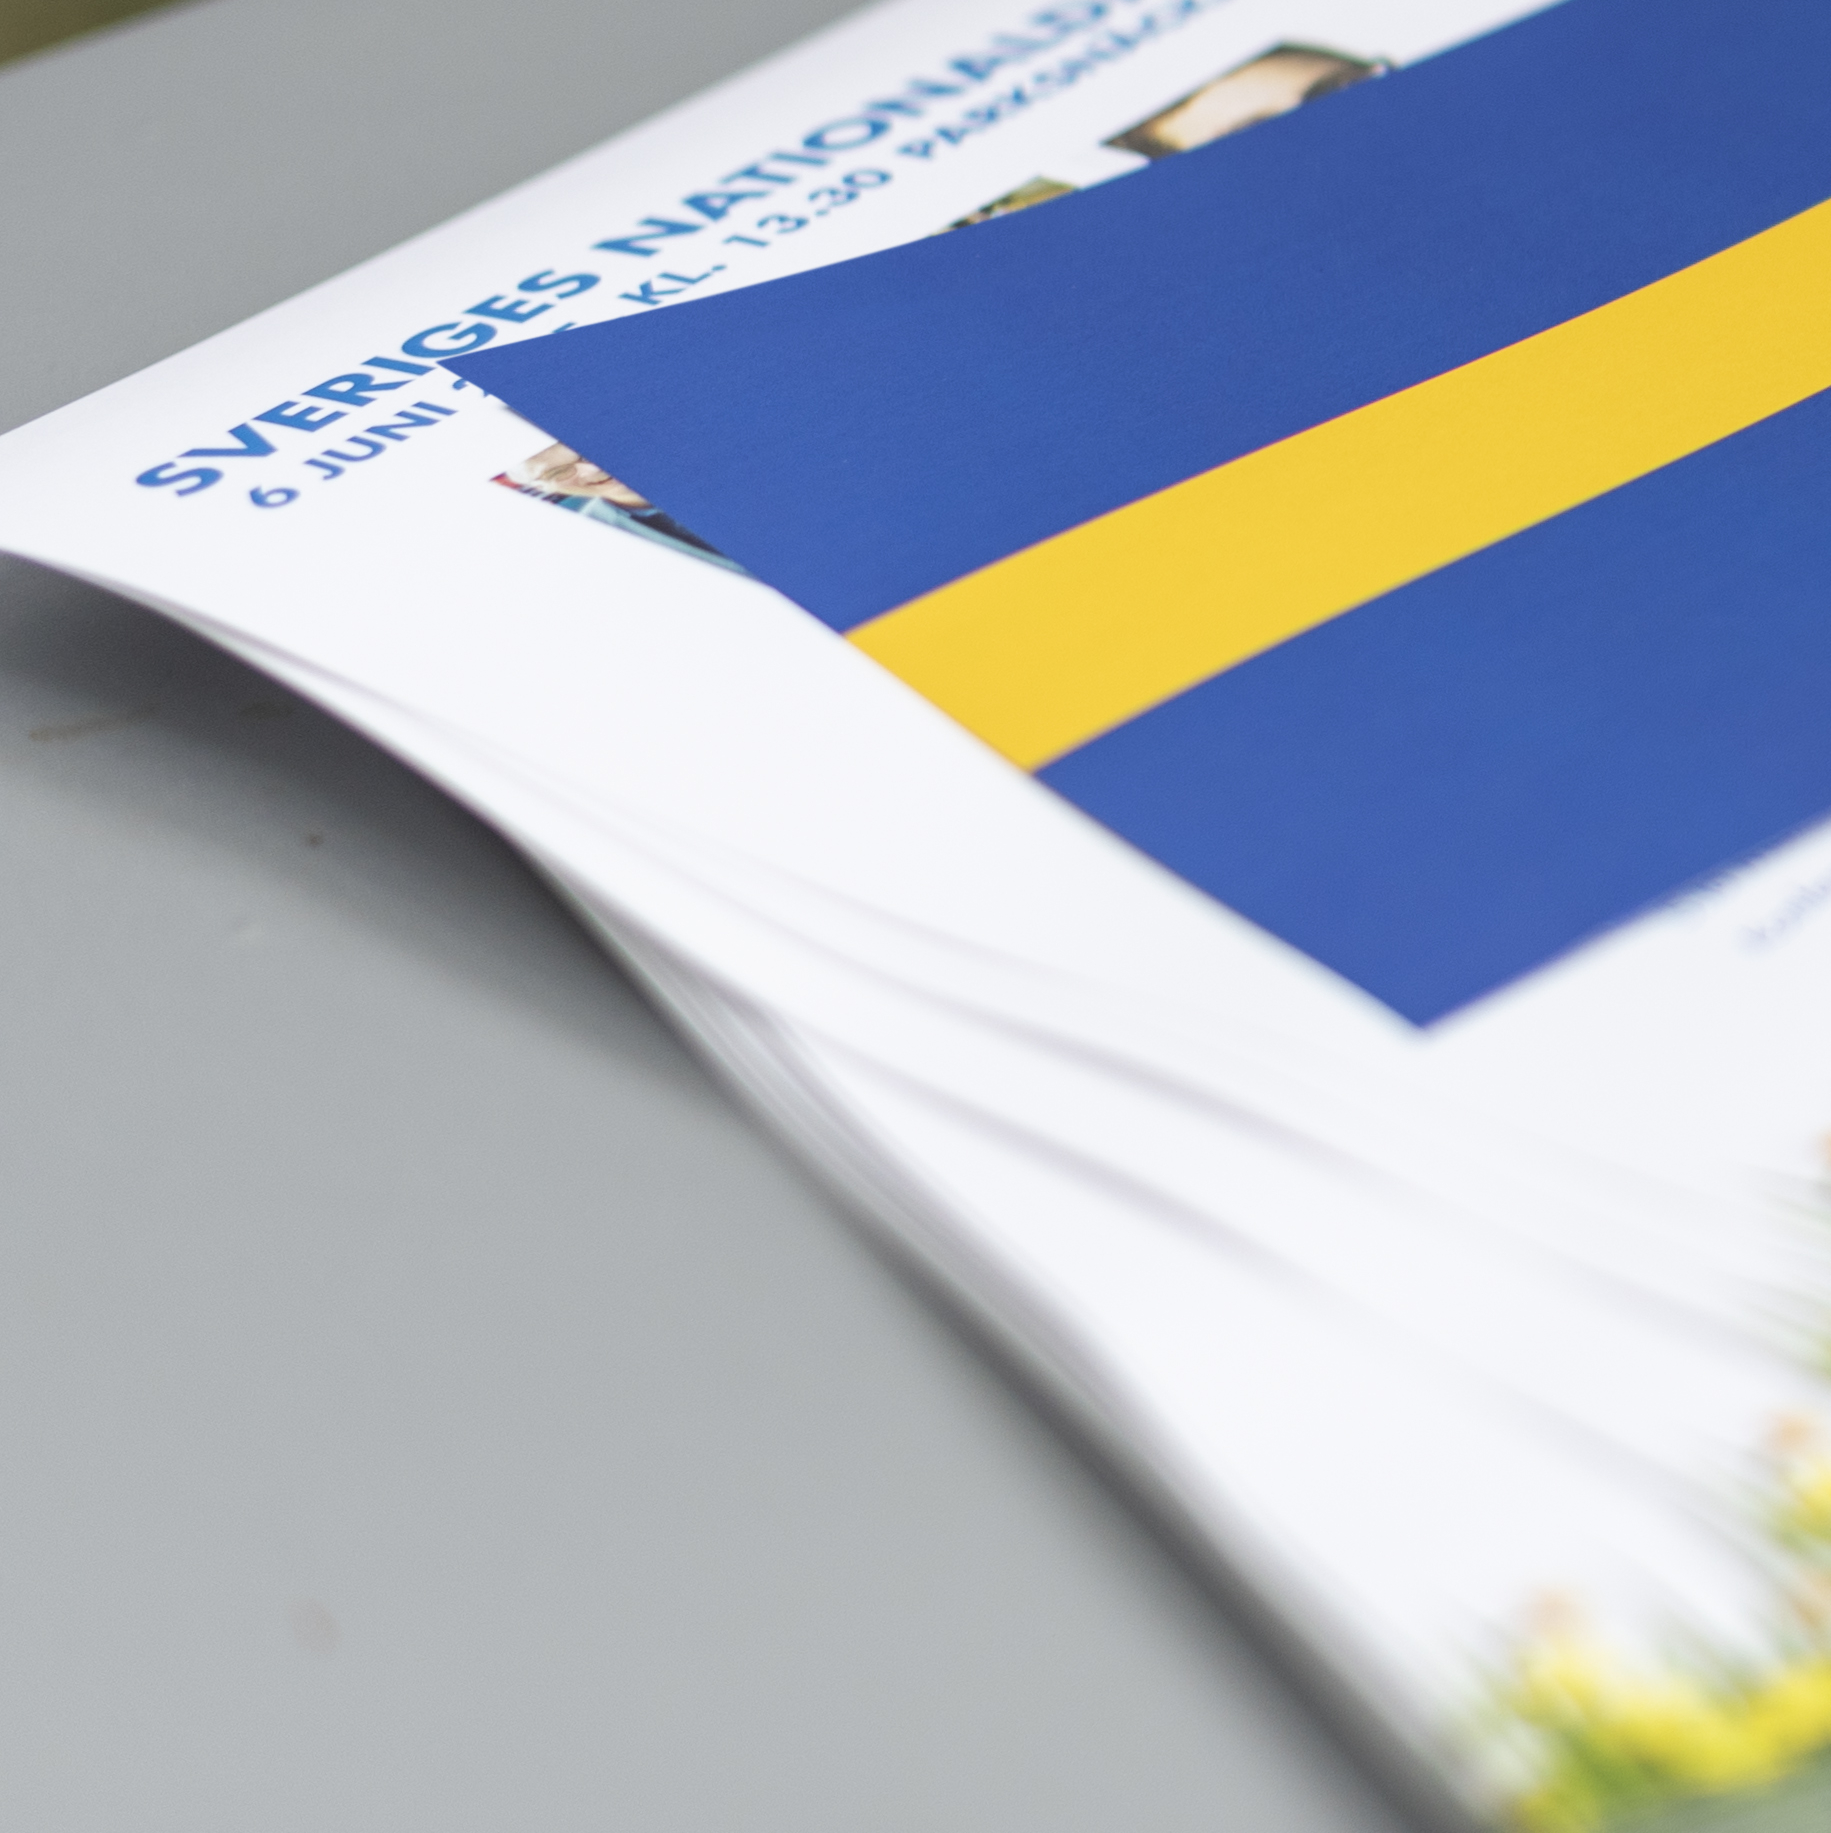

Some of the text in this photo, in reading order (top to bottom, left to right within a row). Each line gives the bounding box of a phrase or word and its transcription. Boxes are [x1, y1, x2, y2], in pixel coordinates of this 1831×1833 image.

[136, 268, 602, 496] SVERIGES
[248, 484, 300, 508] 6
[303, 400, 459, 480] JUNI
[618, 264, 728, 306] KL.
[722, 168, 893, 248] 13.30
